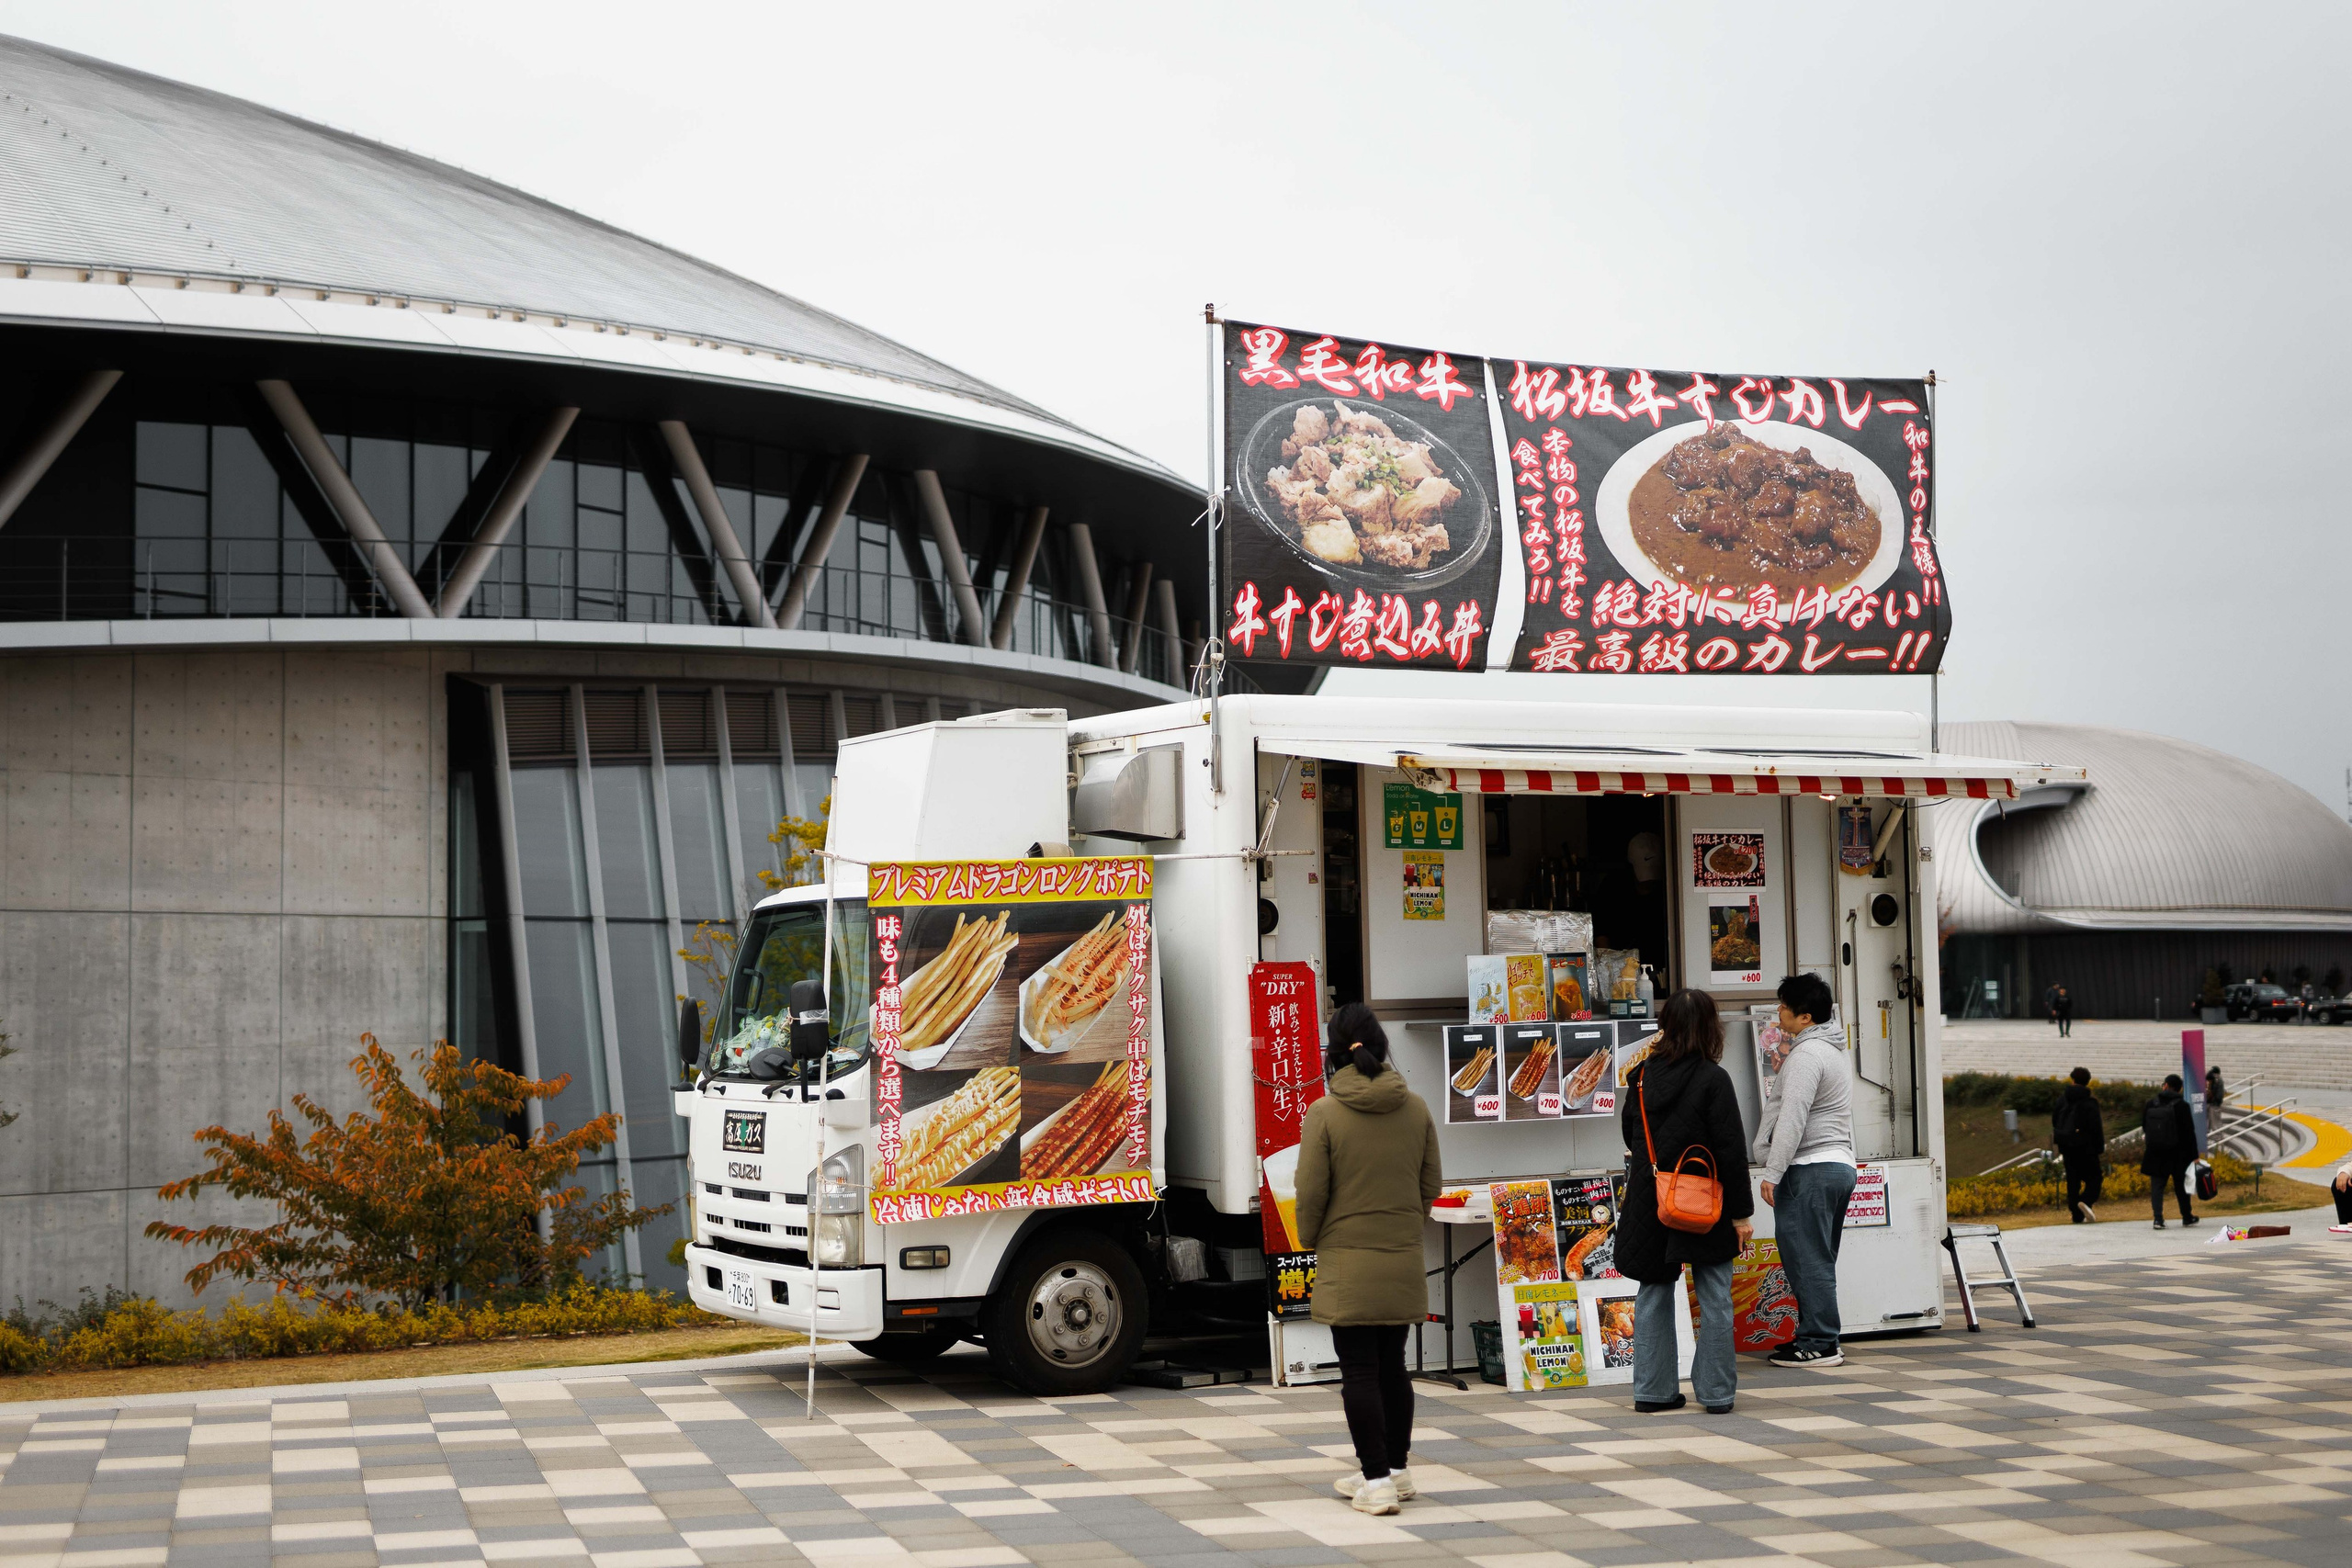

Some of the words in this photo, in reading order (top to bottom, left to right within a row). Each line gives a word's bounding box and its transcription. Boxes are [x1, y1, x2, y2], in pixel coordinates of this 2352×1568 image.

[1240, 328, 1473, 410] 黒毛和牛
[1509, 360, 1917, 430] 松坂牛すじカレー
[1543, 427, 1587, 618] 本物の松坂牛を
[1229, 581, 1483, 670] 牛すじ煮込み丼
[1530, 629, 1931, 672] 最高級のカレー!!
[872, 860, 1150, 900] プレミアムドラゴンロングポテト
[1508, 959, 1533, 975] ハイボール
[1550, 957, 1585, 969] 生ビール
[1742, 972, 1760, 982] ¥600
[1489, 1014, 1509, 1024] ¥500
[1527, 1010, 1547, 1021] ¥600
[1571, 1010, 1592, 1021] ¥800
[1127, 905, 1148, 1168] 外はサクサク中はモチモチ
[876, 917, 902, 1186] 味も4種類から選べます!!
[1289, 1002, 1307, 1139] 飲みごたえとキレのよ
[1477, 1100, 1498, 1111] ¥600
[1541, 1099, 1558, 1109] ¥700
[1596, 1098, 1613, 1108] ¥800
[726, 1121, 762, 1144] 高圧ガス
[729, 1162, 762, 1180] ISUZU
[1562, 1187, 1609, 1205] ものすごい肉汁
[1495, 1196, 1547, 1225] 大鶏排
[1566, 1224, 1608, 1236] フランク
[1739, 1242, 1778, 1260] ポテ
[1537, 1269, 1559, 1280] ¥700
[1518, 1287, 1574, 1300] 日南レモネード
[1530, 1344, 1575, 1357] NICHINAN
[1537, 1357, 1567, 1368] LEMON
